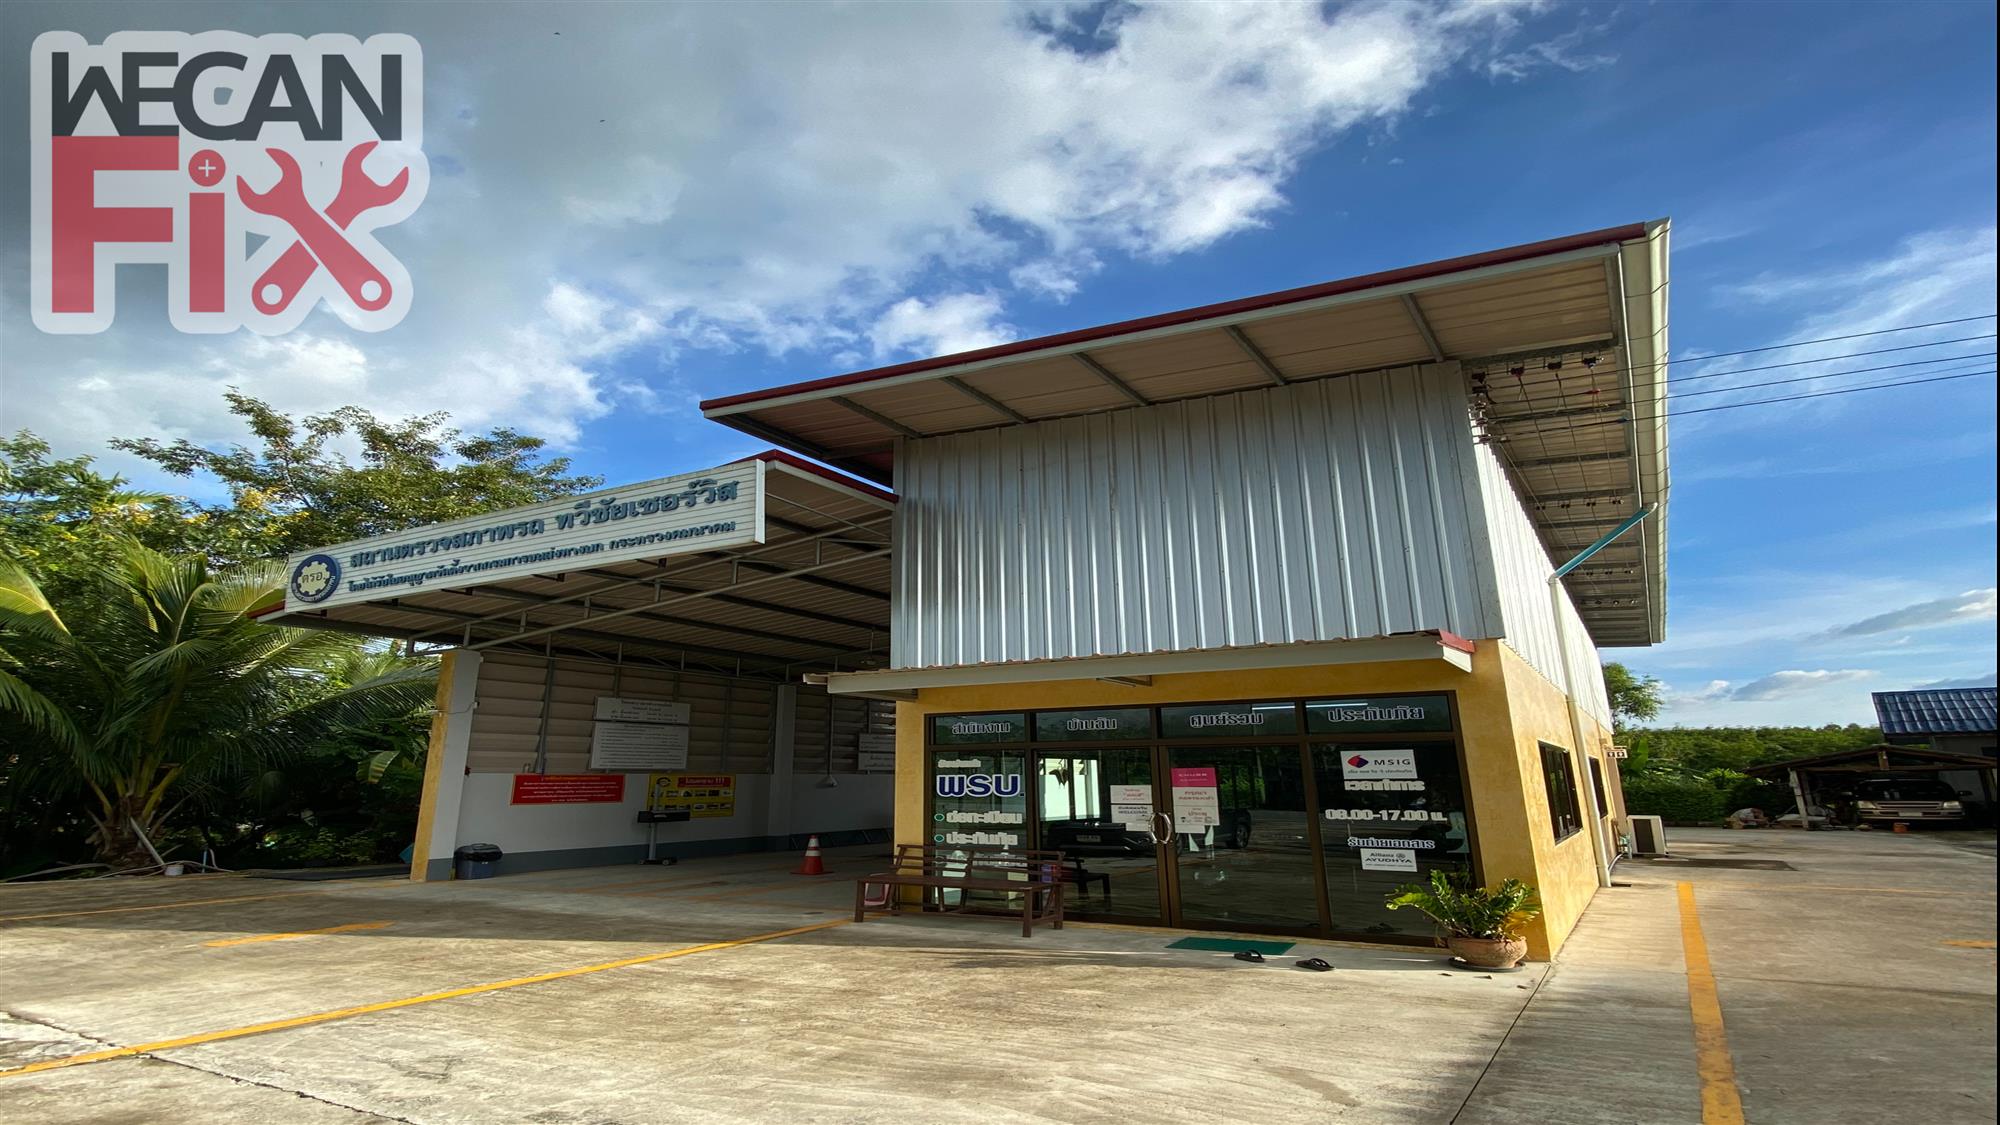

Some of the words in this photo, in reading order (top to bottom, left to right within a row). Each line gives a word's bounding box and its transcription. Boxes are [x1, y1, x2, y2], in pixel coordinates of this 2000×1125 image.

[350, 518, 545, 568] สถานตรวจสภาพรถ
[556, 478, 740, 531] ทวีชัยเซอร์วิส
[609, 521, 736, 551] กระทรวงคมนาคม
[951, 721, 1011, 735] สำนักงาน
[1190, 711, 1264, 729] ศูนย์รวม
[1327, 705, 1425, 722] ประกันภัย
[1374, 758, 1411, 766] MSIG
[1325, 808, 1429, 821] 08.00-17.00
[1346, 836, 1436, 850] รับถ่ายเอกสาร
